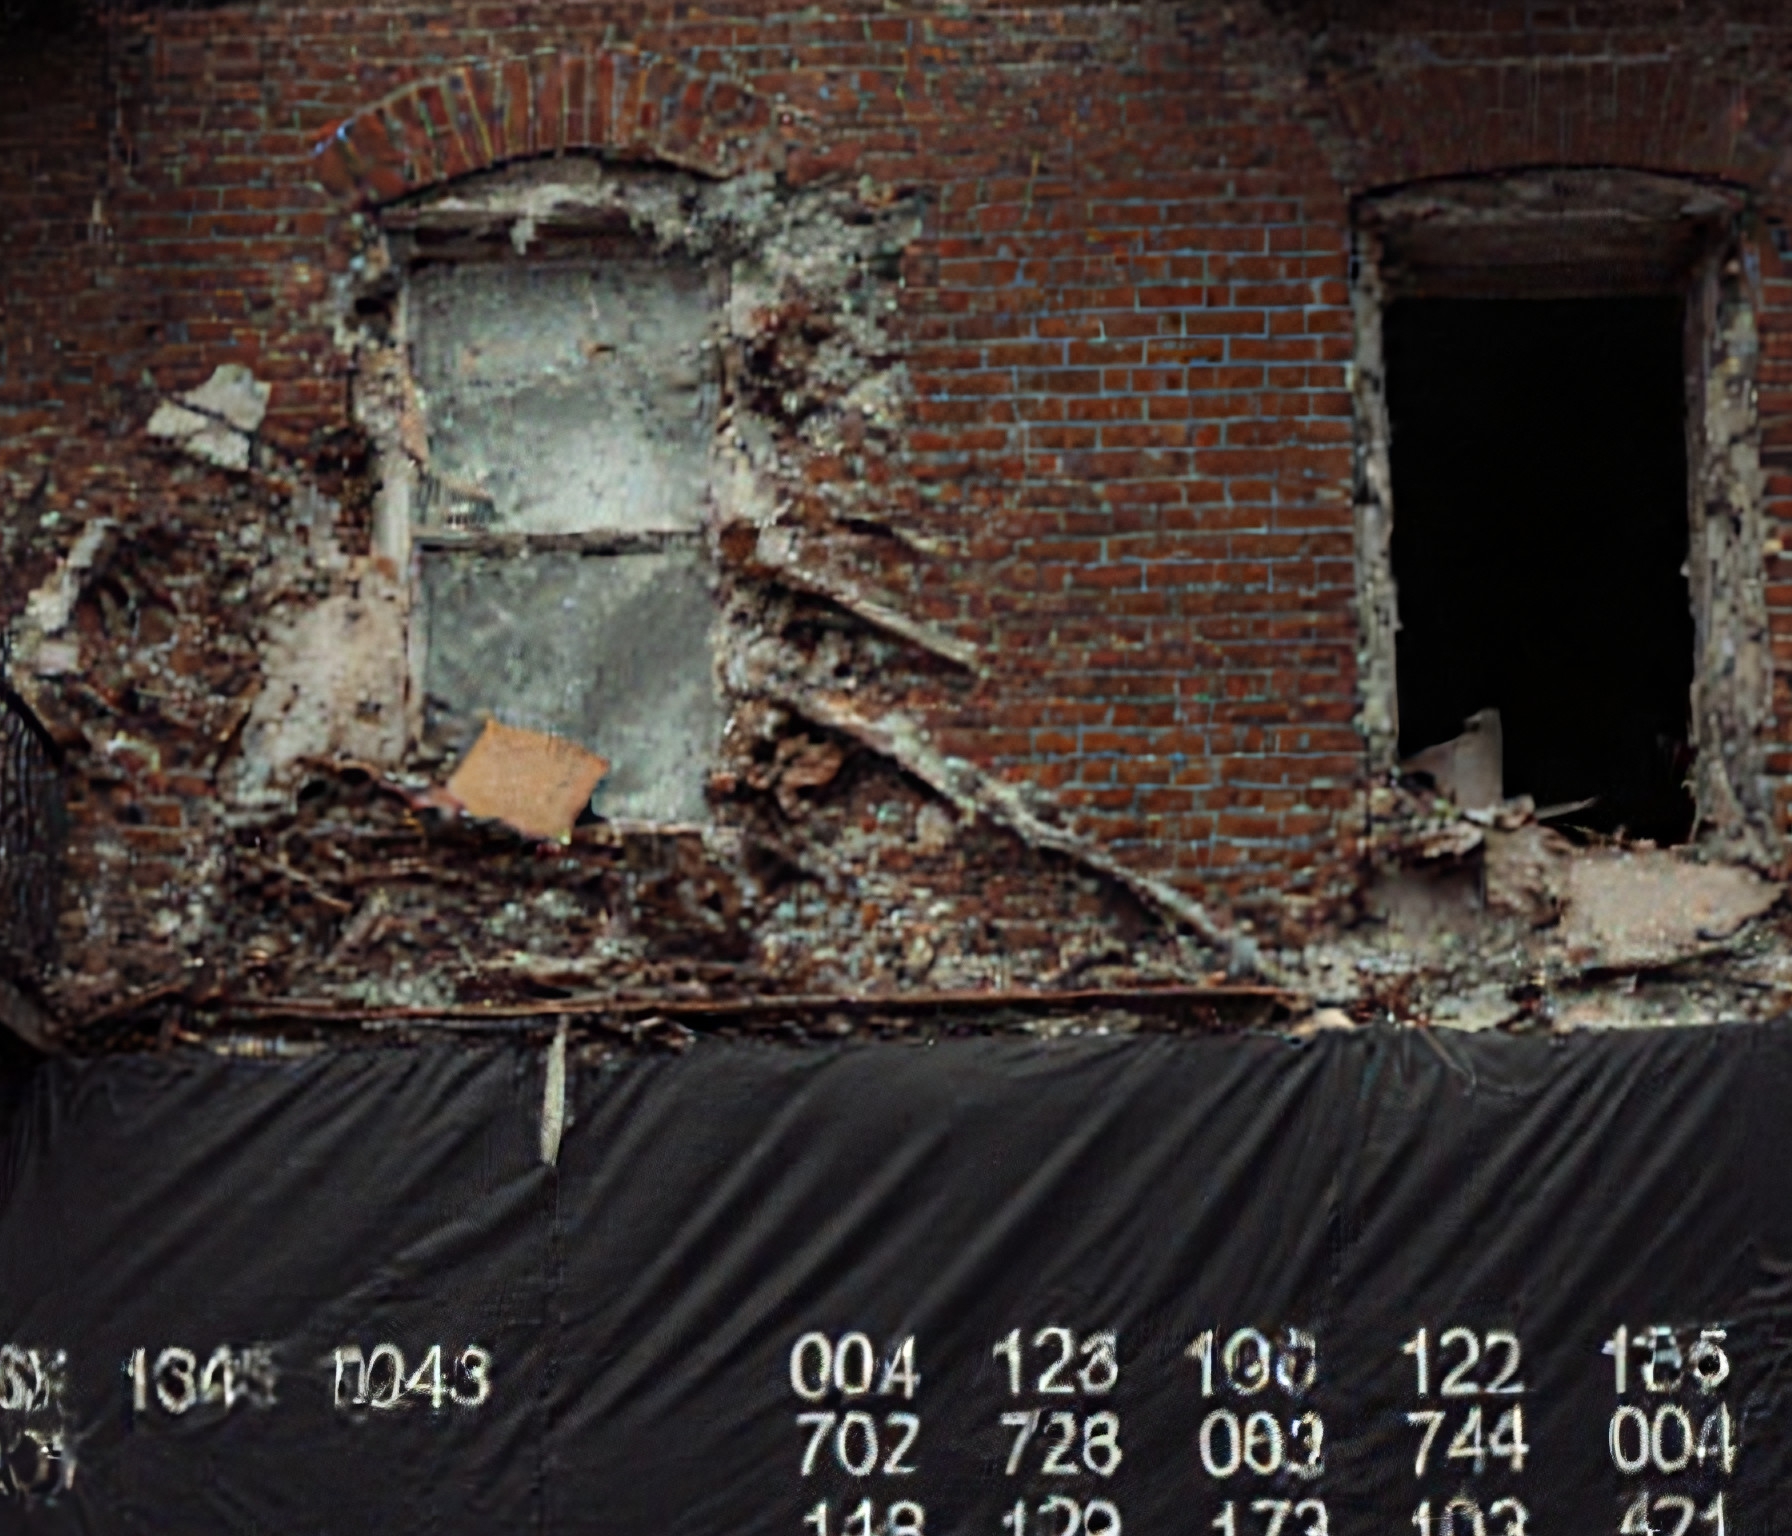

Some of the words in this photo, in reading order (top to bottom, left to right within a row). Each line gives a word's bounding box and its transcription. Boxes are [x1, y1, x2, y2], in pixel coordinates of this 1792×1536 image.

[790, 1331, 920, 1400] 004
[1402, 1326, 1526, 1396] 122
[796, 1410, 921, 1477] 702
[1406, 1403, 1530, 1477] 744
